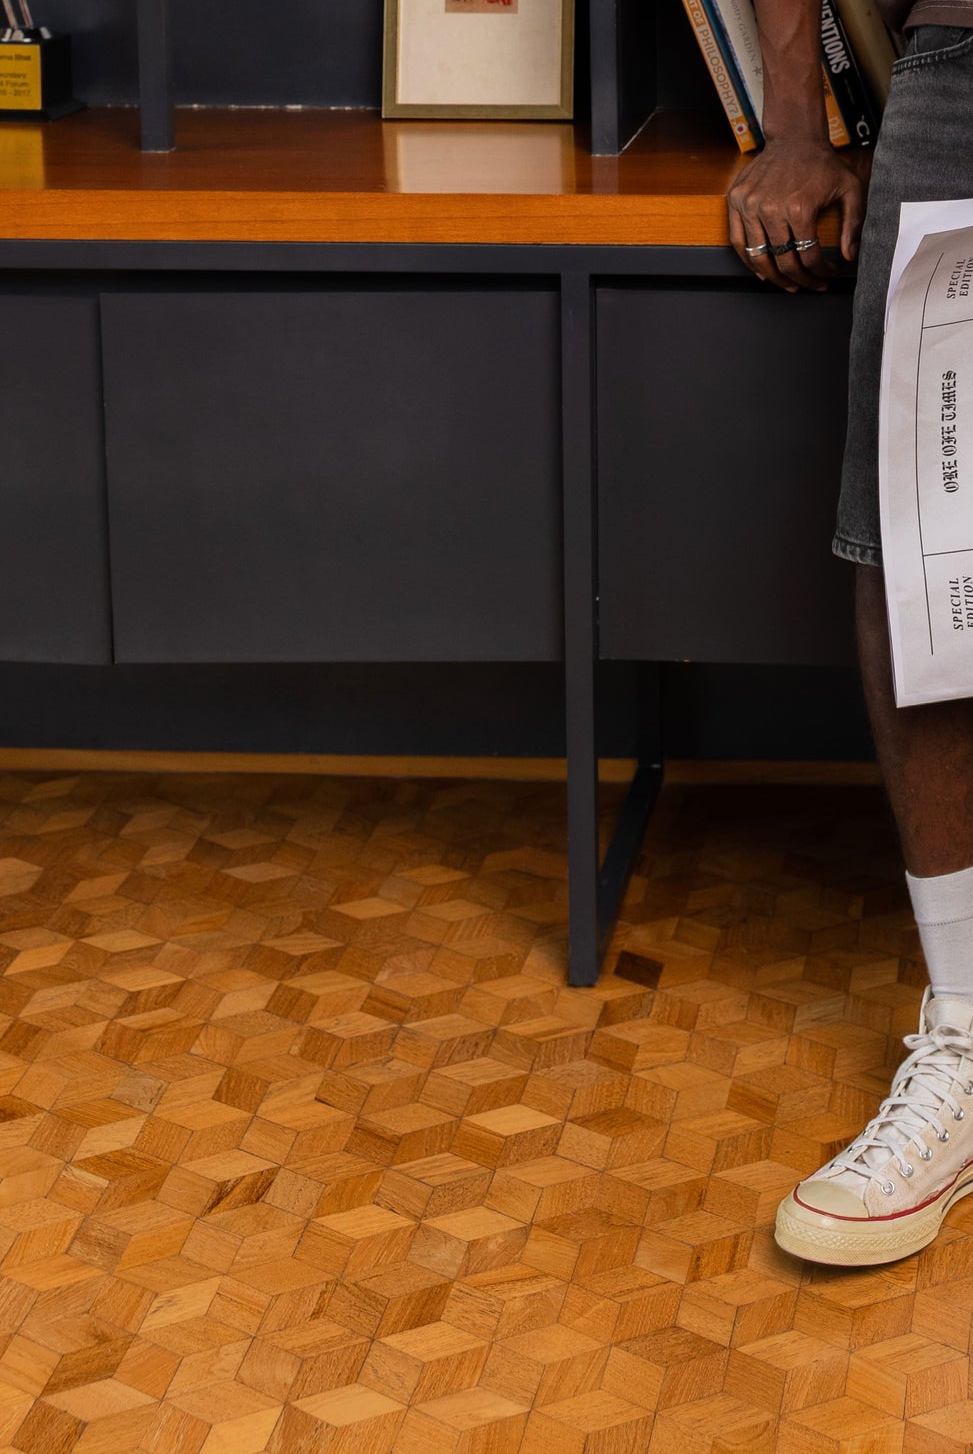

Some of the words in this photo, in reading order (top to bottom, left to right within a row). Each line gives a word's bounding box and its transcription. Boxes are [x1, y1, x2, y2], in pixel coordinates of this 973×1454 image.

[736, 22, 756, 62] GARDEN
[692, 10, 704, 25] OF
[699, 28, 741, 117] PHILOSOPHY?
[946, 258, 966, 299] SPECIAL
[941, 370, 957, 422] TIMES
[941, 426, 957, 457] OFE
[943, 459, 959, 493] ORE
[948, 577, 964, 631] SPECIAL
